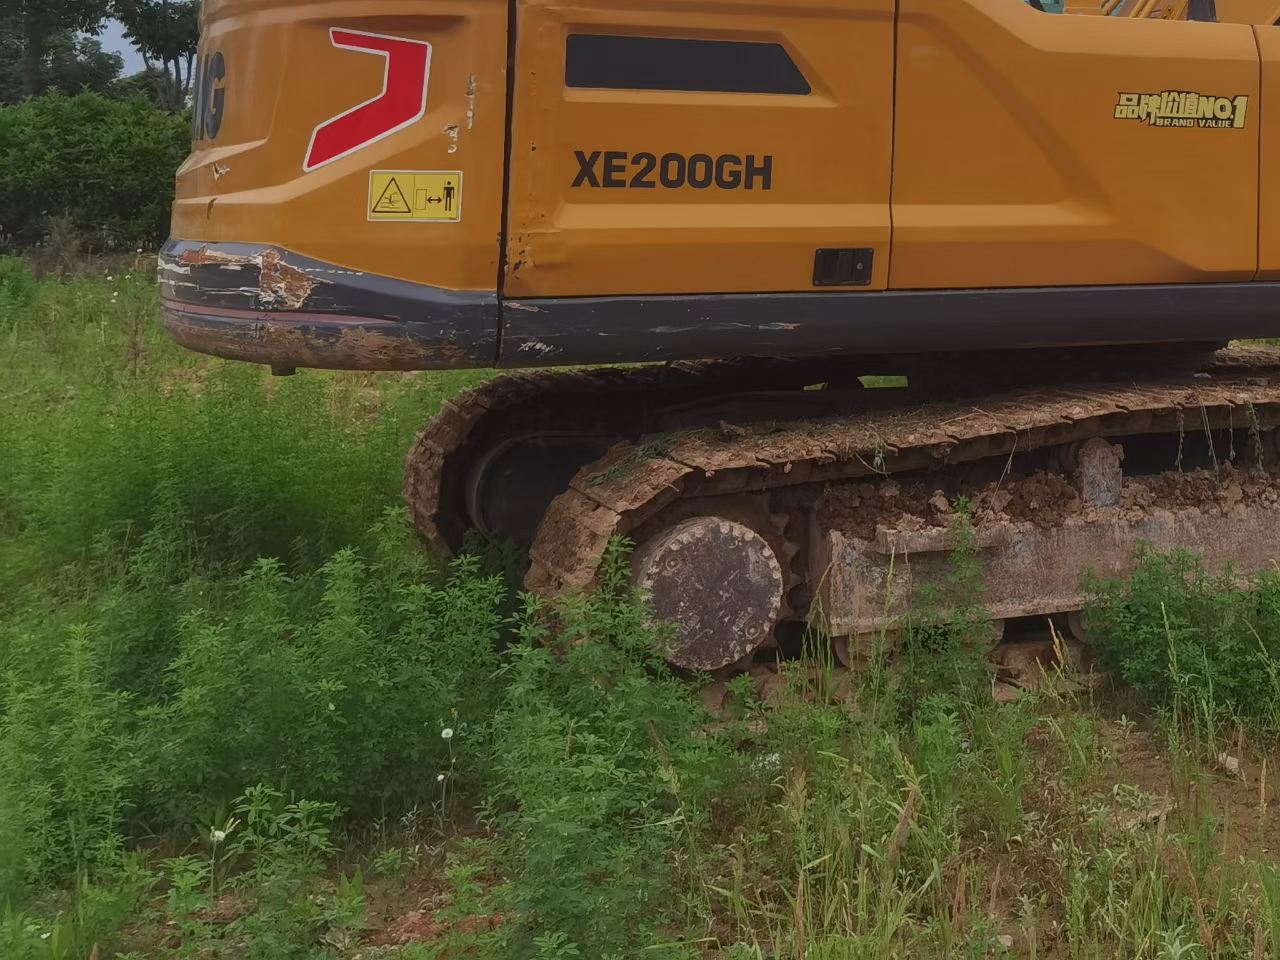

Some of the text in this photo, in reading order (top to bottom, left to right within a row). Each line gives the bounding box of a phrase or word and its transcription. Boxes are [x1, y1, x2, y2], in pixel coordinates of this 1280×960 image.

[1155, 118, 1232, 128] BRAND VALUE
[571, 150, 773, 190] XE200GH
